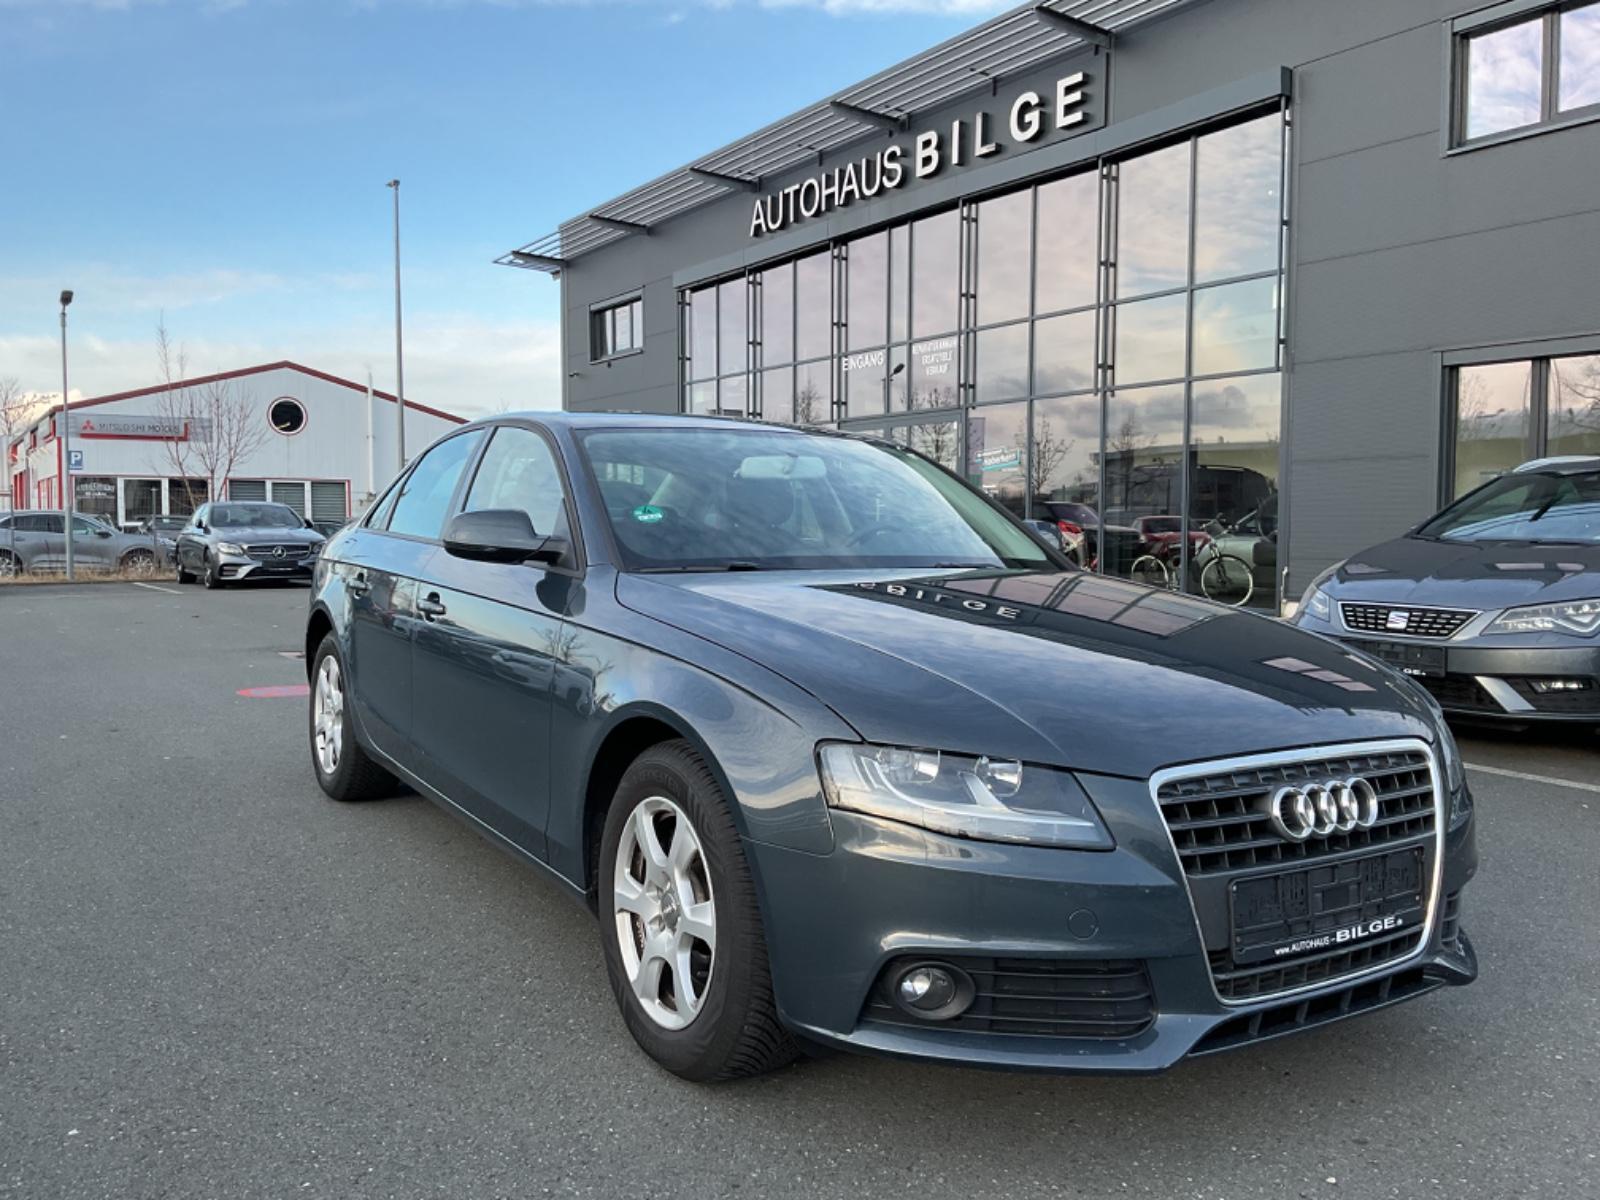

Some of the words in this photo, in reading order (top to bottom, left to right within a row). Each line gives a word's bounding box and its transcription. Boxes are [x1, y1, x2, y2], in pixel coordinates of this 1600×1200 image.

[750, 146, 903, 238] AUTOHAUS
[915, 71, 1085, 179] BILGE
[70, 451, 81, 465] P
